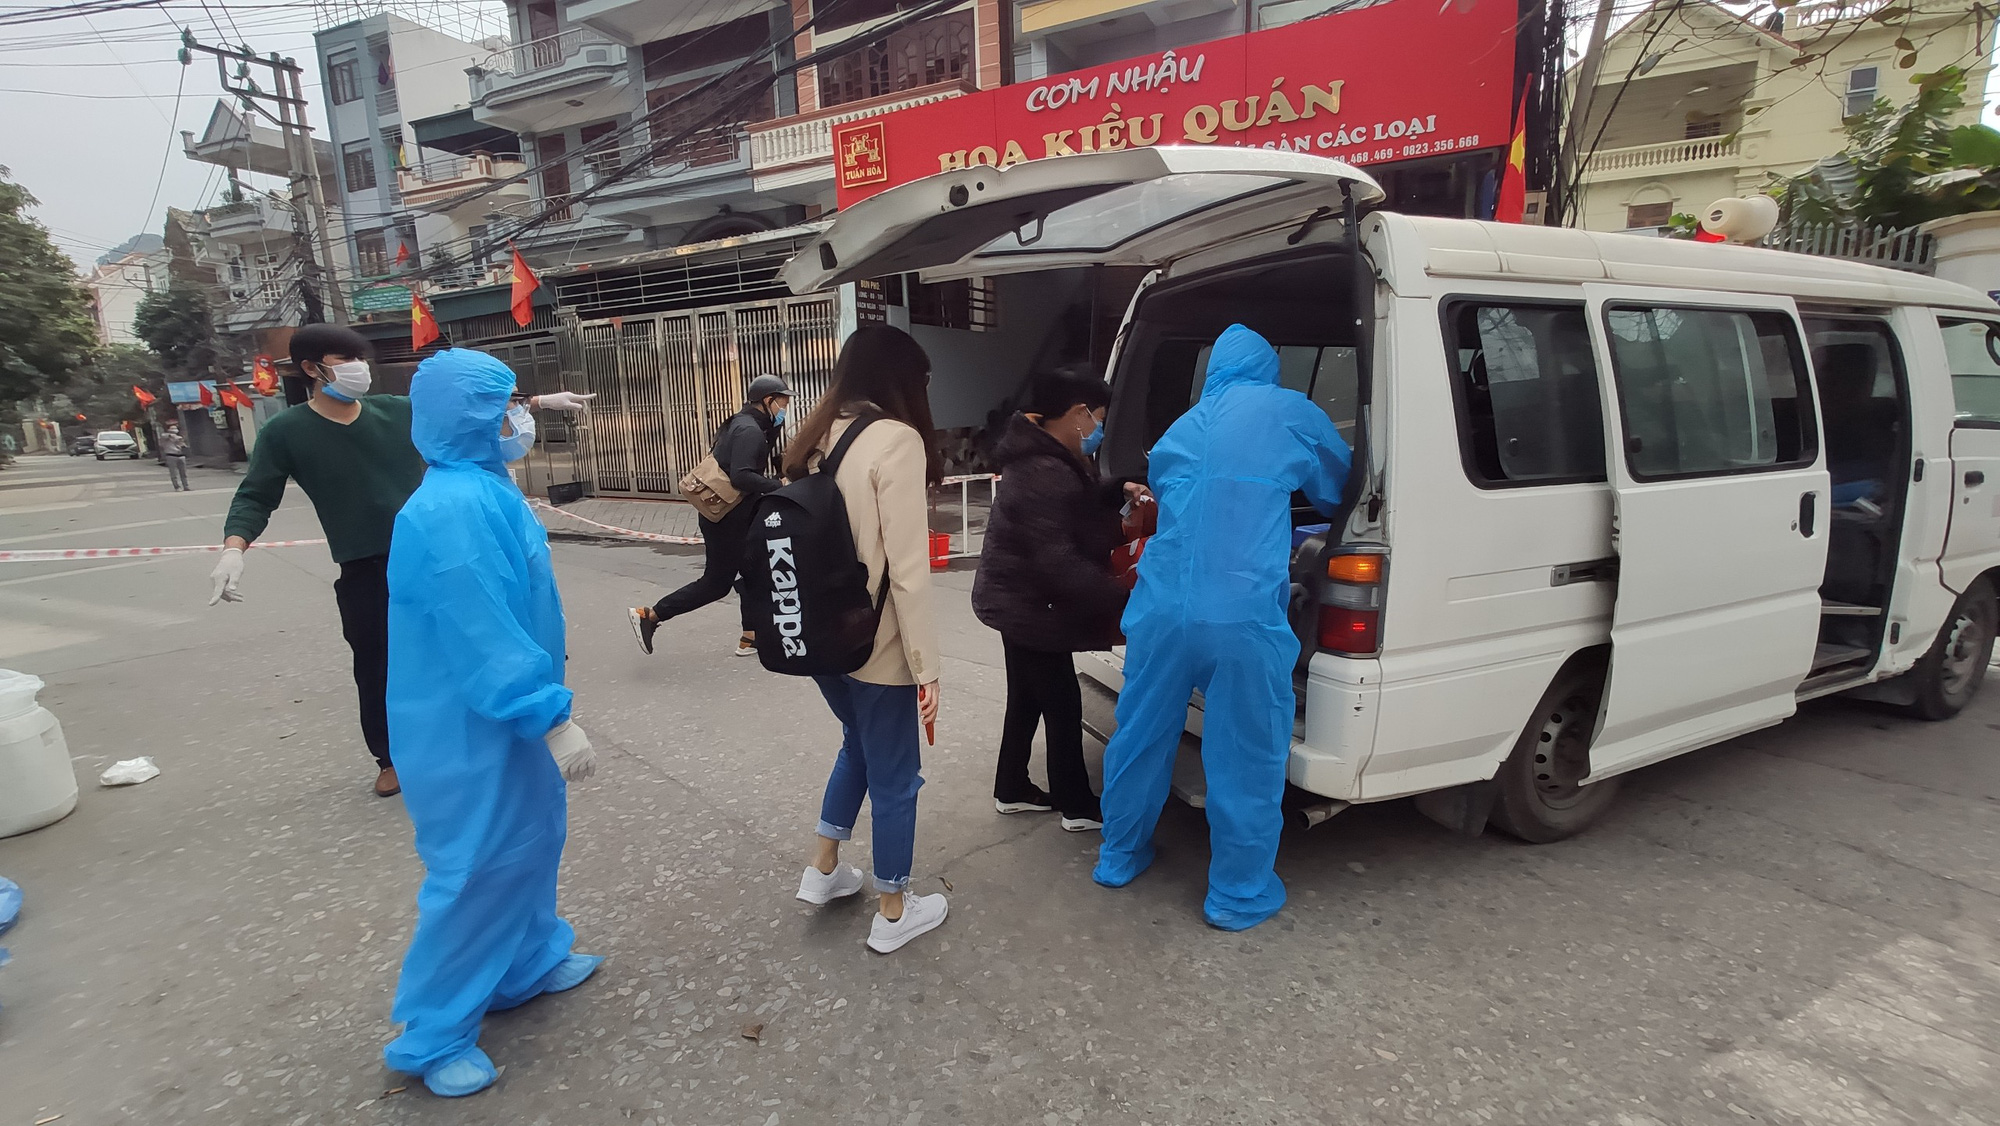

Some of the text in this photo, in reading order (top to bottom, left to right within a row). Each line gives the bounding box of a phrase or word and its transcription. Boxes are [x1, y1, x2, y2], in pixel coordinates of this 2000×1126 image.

[1025, 50, 1205, 112] CƠM NHẬU
[938, 76, 1345, 172] HOA KIỀU QUÁN
[1316, 123, 1367, 149] CÁC
[1373, 114, 1437, 140] LOẠI
[1402, 135, 1479, 157] 0823.356.668
[766, 537, 807, 659] Kappa
